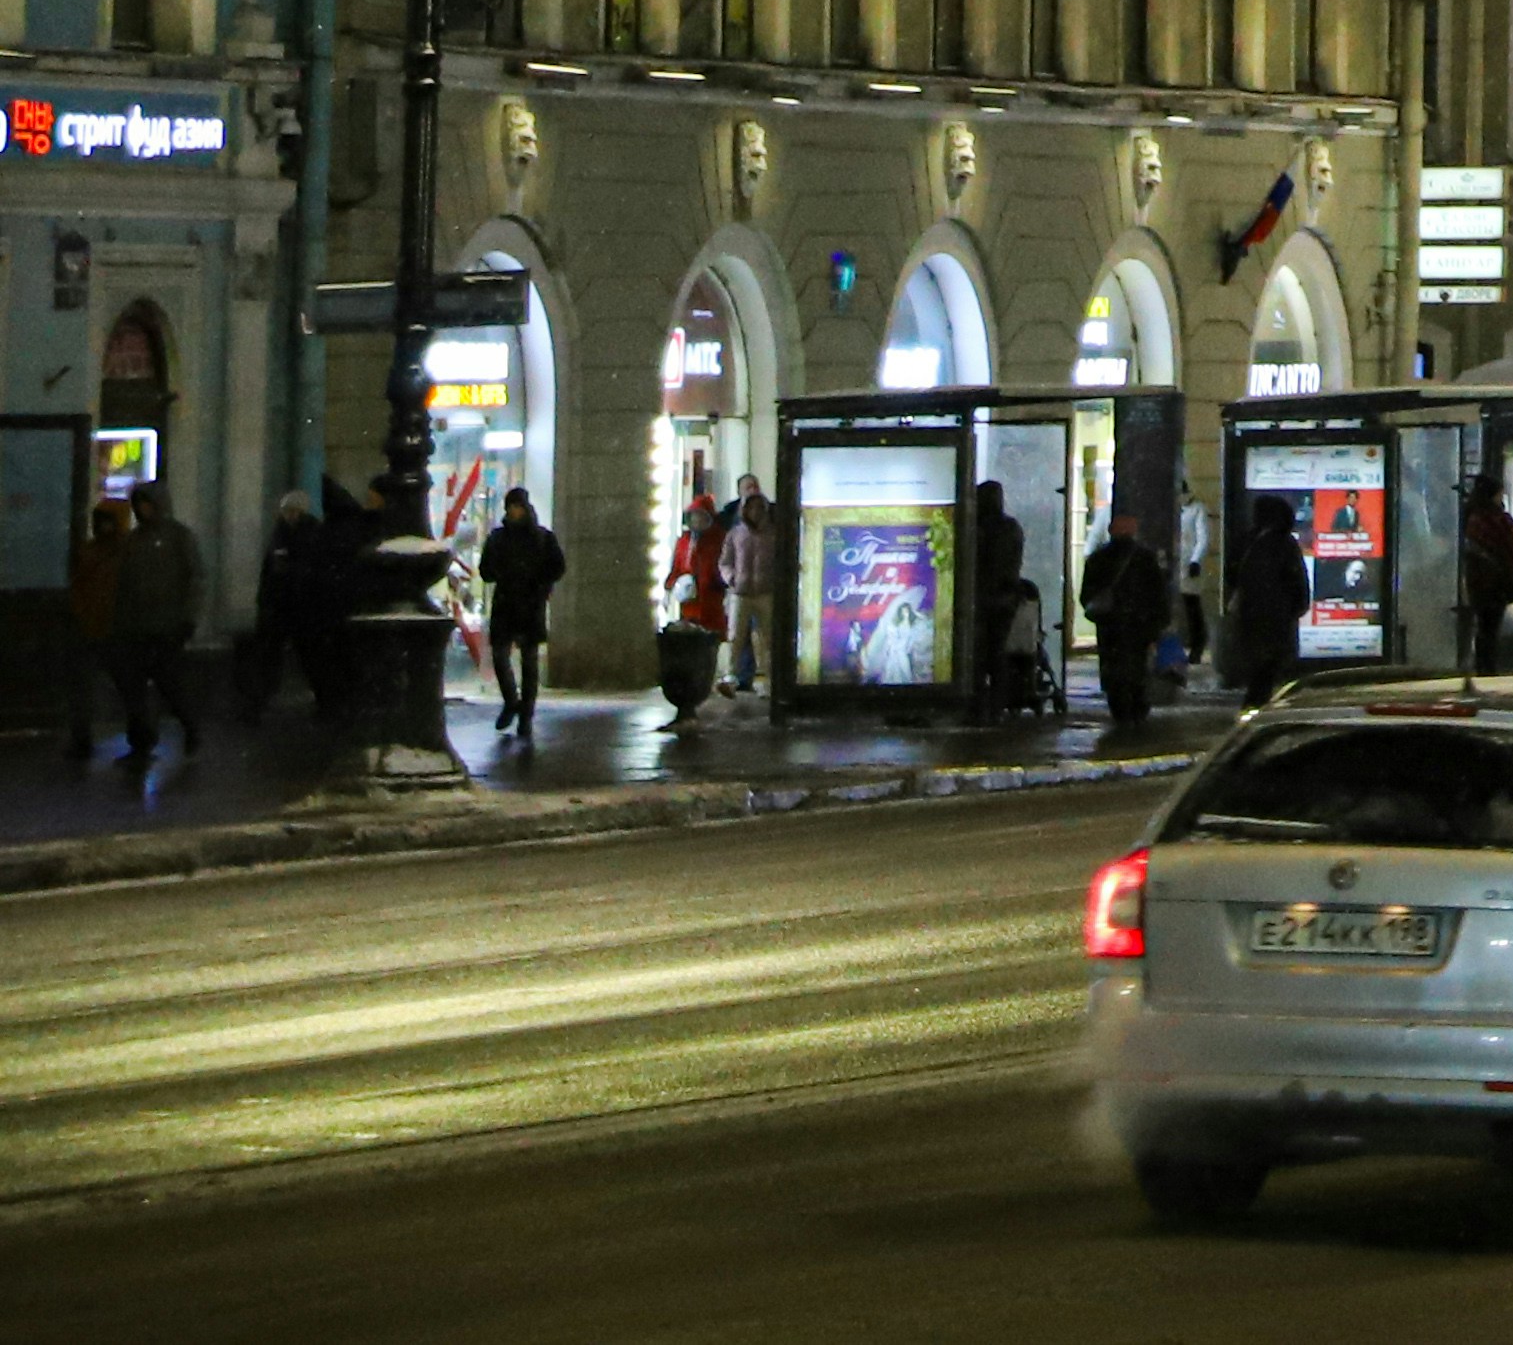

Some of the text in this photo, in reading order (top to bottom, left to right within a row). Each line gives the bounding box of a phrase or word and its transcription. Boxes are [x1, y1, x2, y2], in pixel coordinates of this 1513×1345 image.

[58, 112, 126, 157] стрит
[127, 104, 171, 158] фуд
[172, 117, 226, 150] азия
[685, 341, 722, 375] МТС
[1250, 362, 1321, 396] INCANTO
